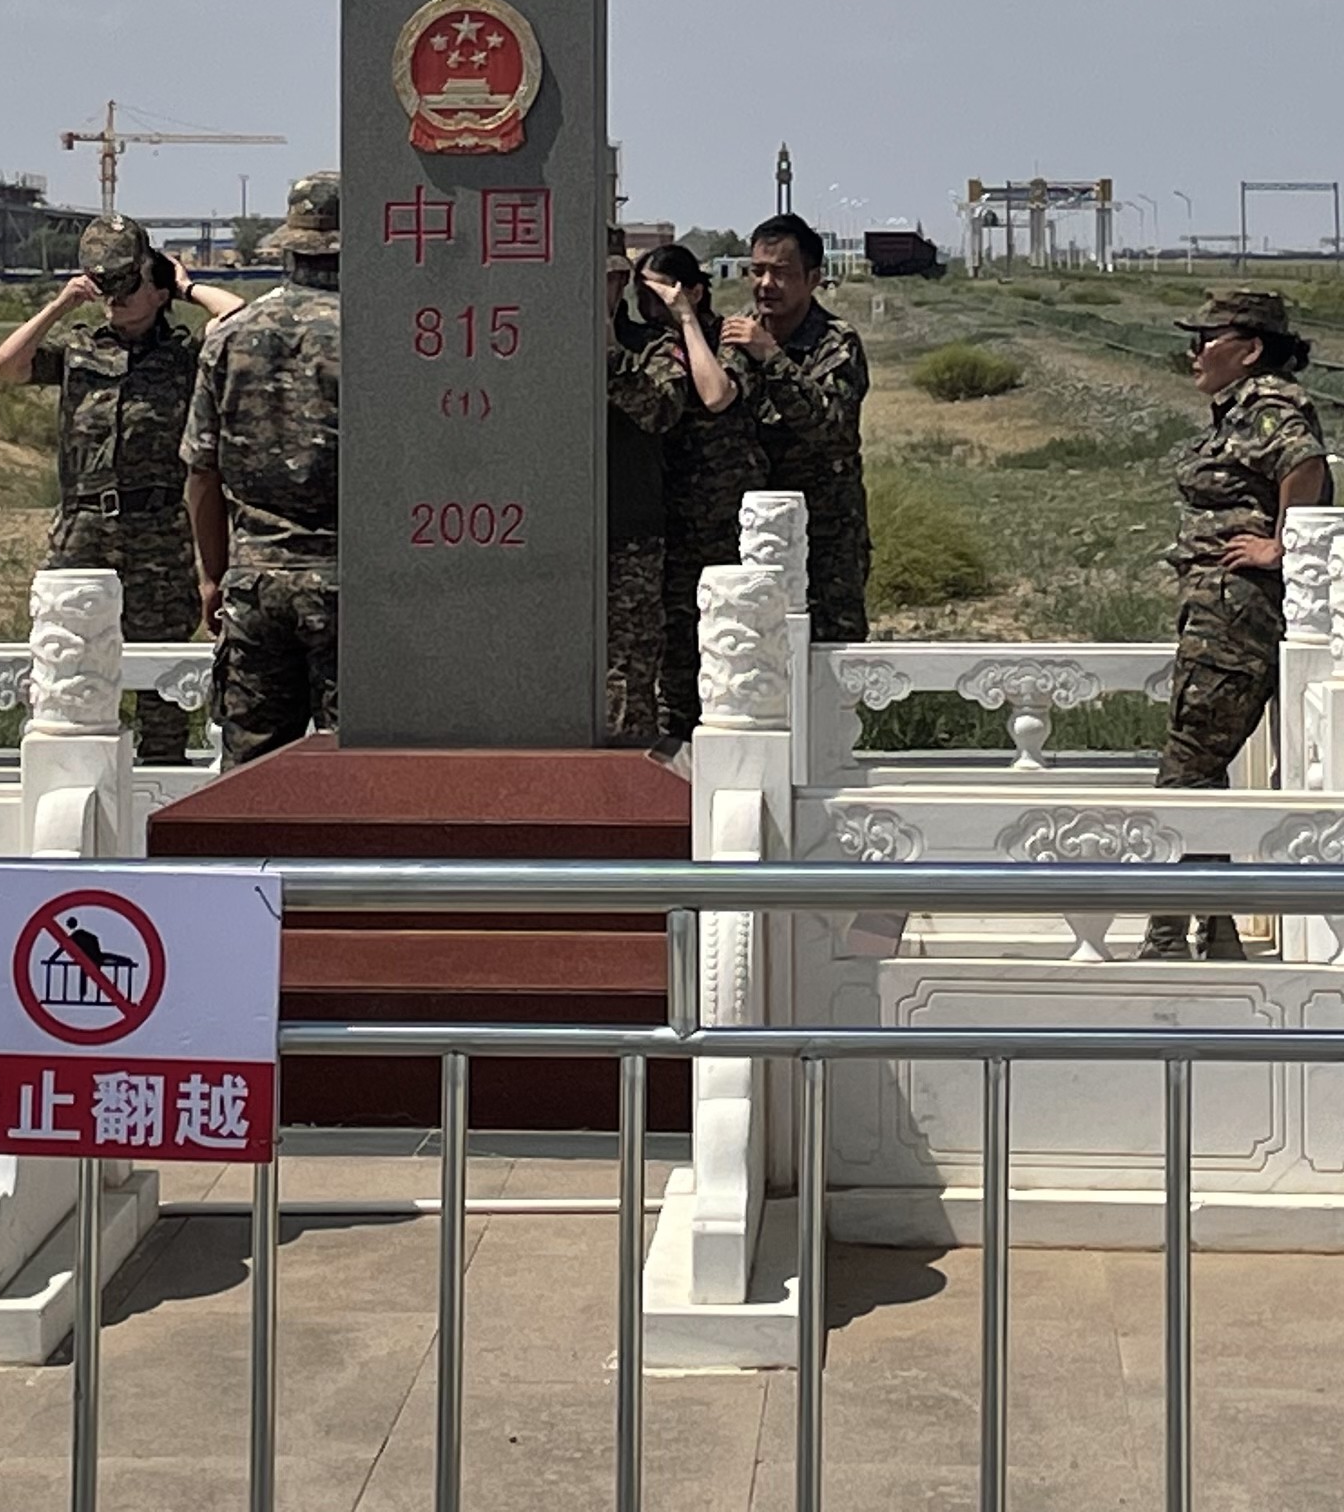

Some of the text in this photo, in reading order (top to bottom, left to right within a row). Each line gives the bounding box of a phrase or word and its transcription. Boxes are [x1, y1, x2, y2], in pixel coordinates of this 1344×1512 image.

[384, 184, 552, 266] 中国
[413, 305, 521, 358] 815
[441, 388, 492, 420] (1)
[410, 502, 526, 548] 2002
